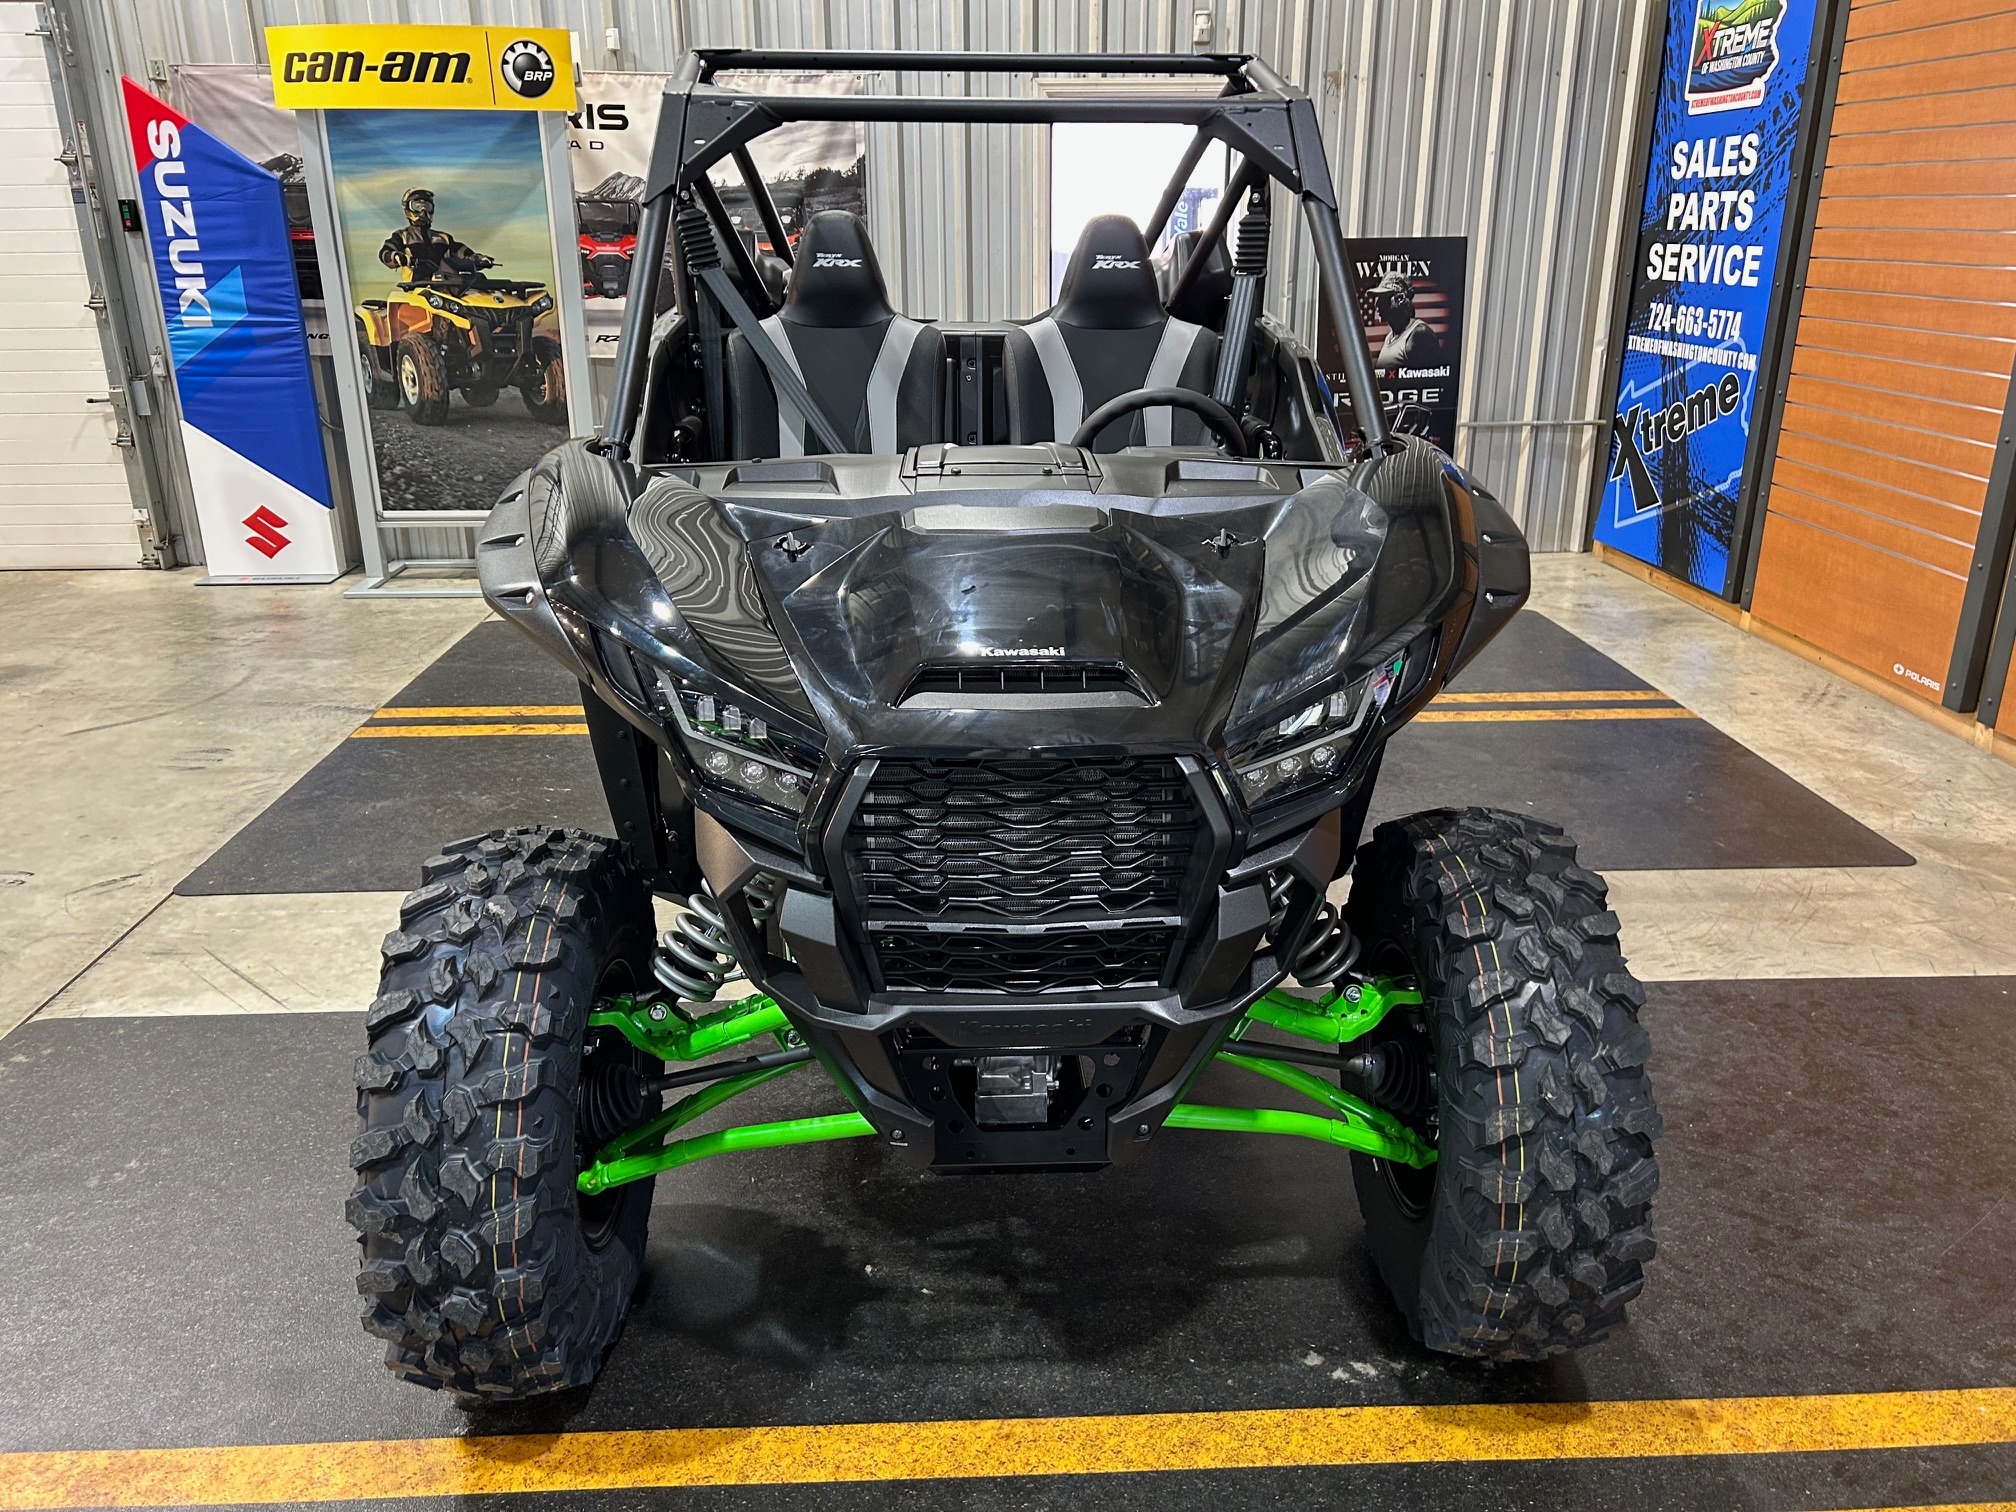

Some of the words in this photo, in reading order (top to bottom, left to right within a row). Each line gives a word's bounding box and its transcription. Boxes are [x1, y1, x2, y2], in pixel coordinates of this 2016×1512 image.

[1694, 18, 1773, 67] XTREME
[283, 51, 471, 83] can-am
[523, 69, 553, 82] BRP
[1701, 61, 1710, 75] OF
[1709, 55, 1743, 73] WASHINGTON
[1742, 50, 1766, 67] COUNTY
[1671, 133, 1759, 180] SALES
[147, 119, 214, 327] SUZUKI
[1666, 190, 1755, 231] PARTS
[812, 257, 863, 268] KRX
[1091, 260, 1141, 270] KRX
[1379, 254, 1410, 262] MORGAN
[1647, 242, 1763, 287] SERVICE
[1648, 302, 1743, 342] 724-663-5774
[1628, 335, 1757, 371] XTREMEOFWASHINGTONCOUNTYCOM
[1398, 365, 1450, 379] Kawasaki
[1333, 388, 1441, 407] RDGE
[1610, 372, 1741, 513] Xtreme
[981, 646, 1066, 657] Kawasaki
[1905, 668, 1941, 692] POLARIS
